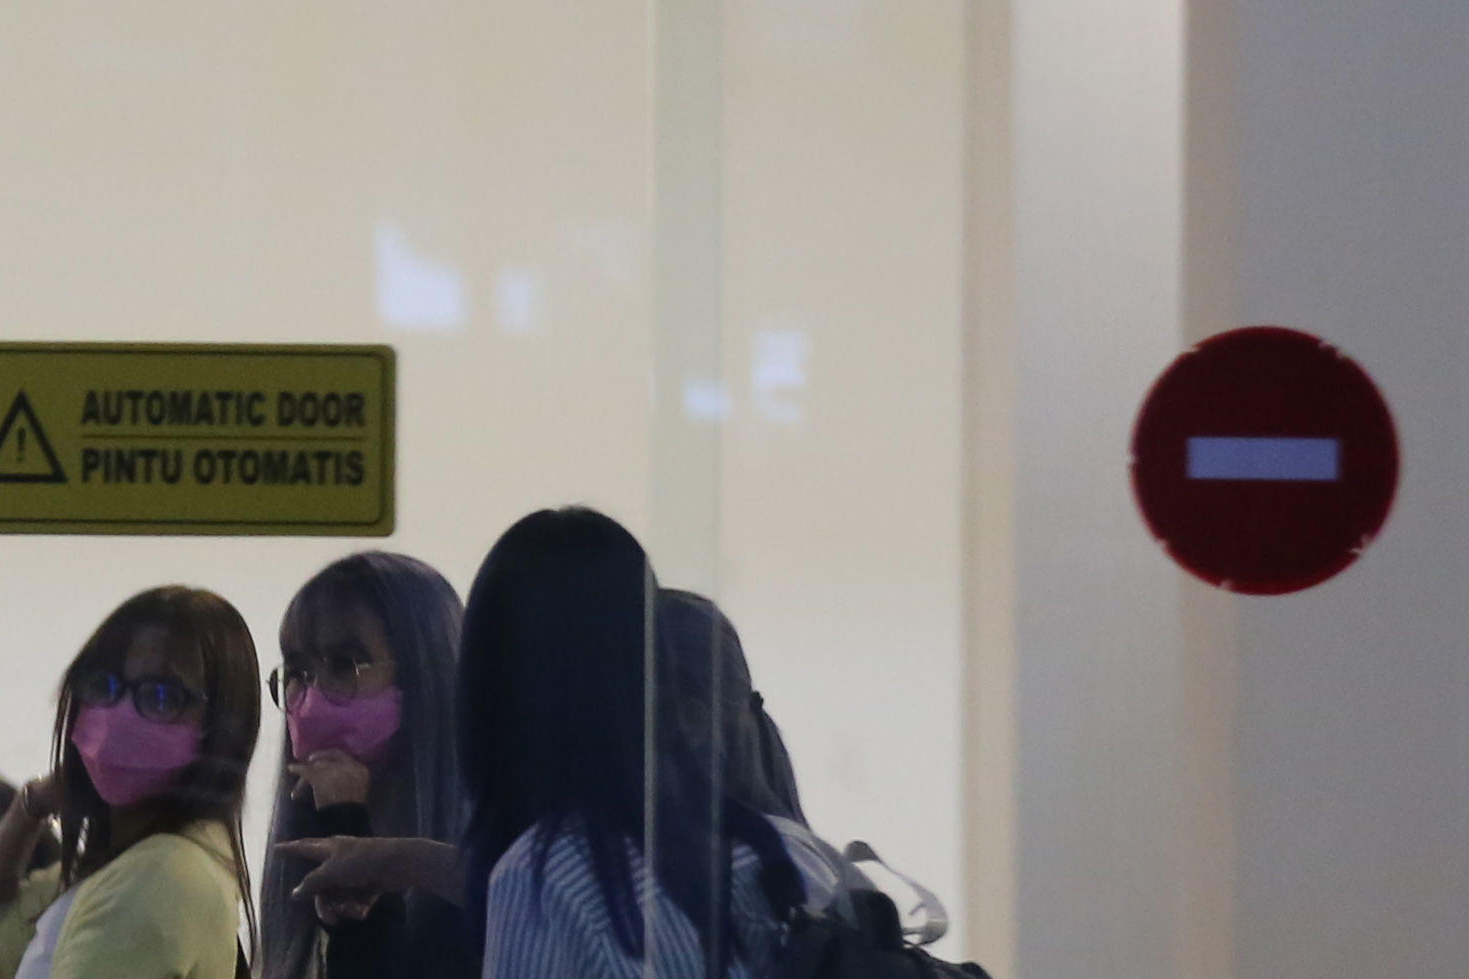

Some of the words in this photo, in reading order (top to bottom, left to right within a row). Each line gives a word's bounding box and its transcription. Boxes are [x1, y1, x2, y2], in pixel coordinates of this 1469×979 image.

[80, 390, 266, 426] AUTOMATIC
[276, 392, 367, 427] DOOR
[81, 448, 182, 484] PINTU
[193, 449, 365, 486] OTOMATIS
